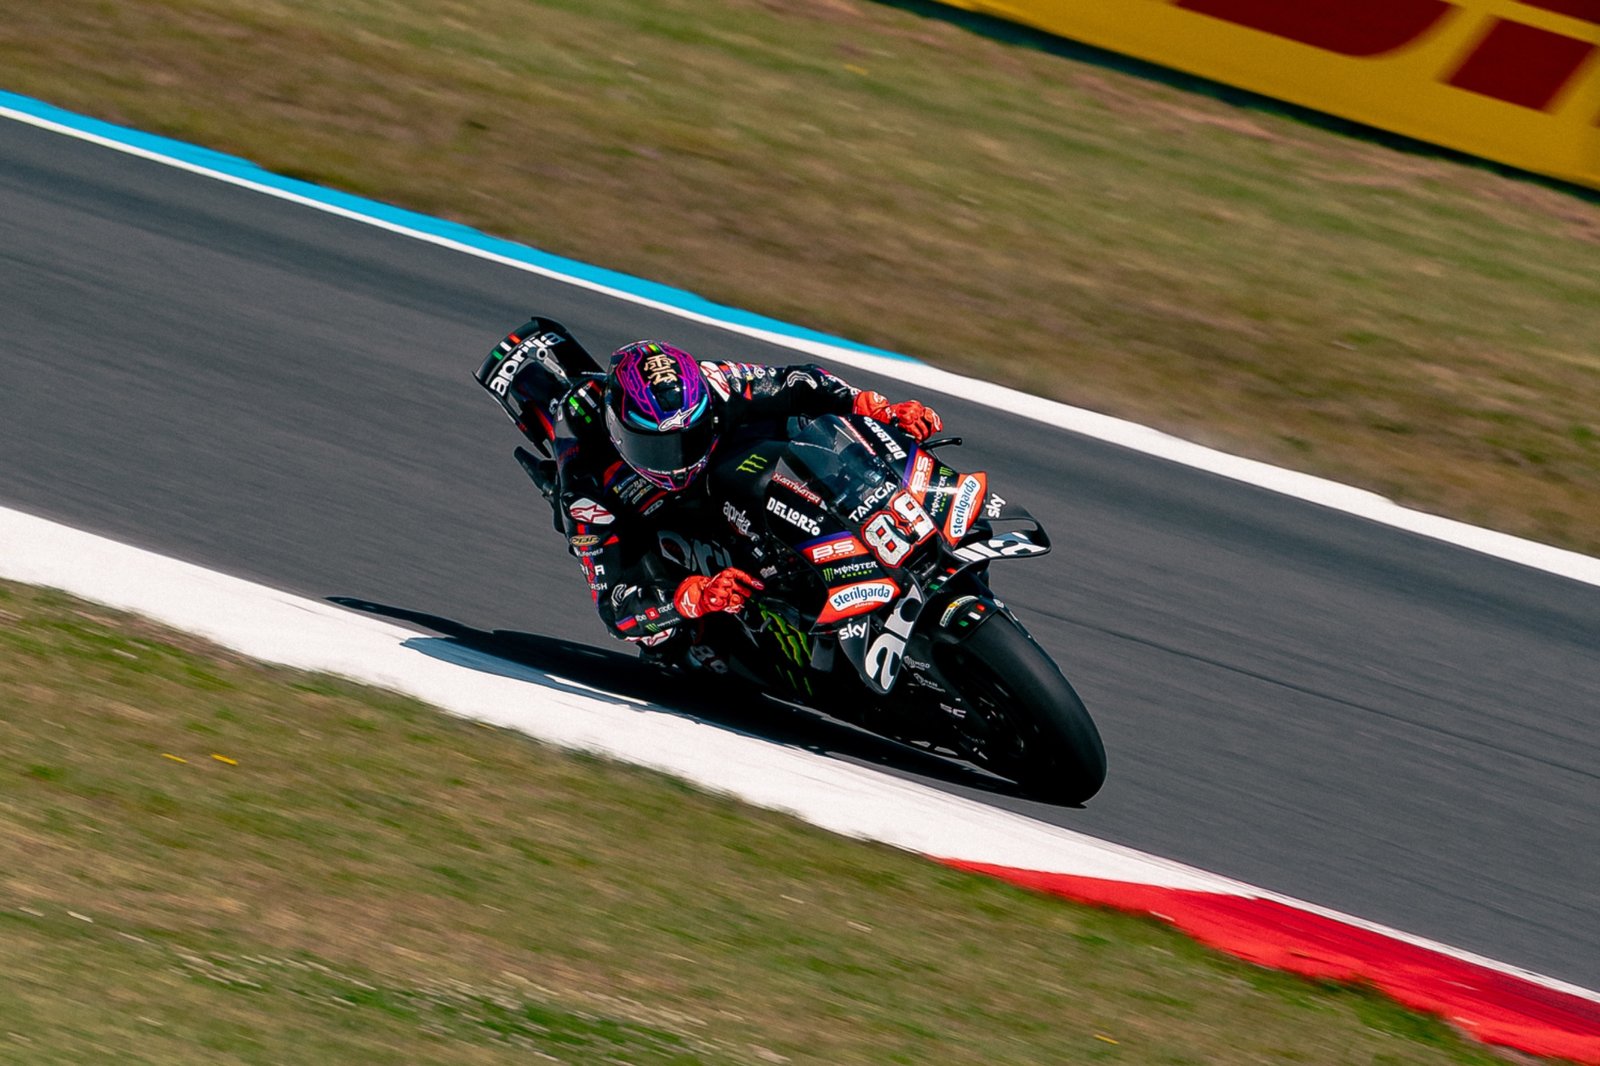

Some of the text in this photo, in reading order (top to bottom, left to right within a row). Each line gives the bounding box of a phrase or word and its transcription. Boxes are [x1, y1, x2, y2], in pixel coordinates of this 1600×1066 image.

[848, 481, 897, 523] TARGA
[954, 480, 977, 535] sterilgarda
[985, 493, 1006, 518] sky
[766, 497, 820, 536] DELLORTO
[862, 490, 937, 568] 89
[812, 540, 855, 559] BS
[833, 561, 878, 576] MONSTER
[834, 585, 891, 608] sterilgarda
[838, 622, 867, 640] sky
